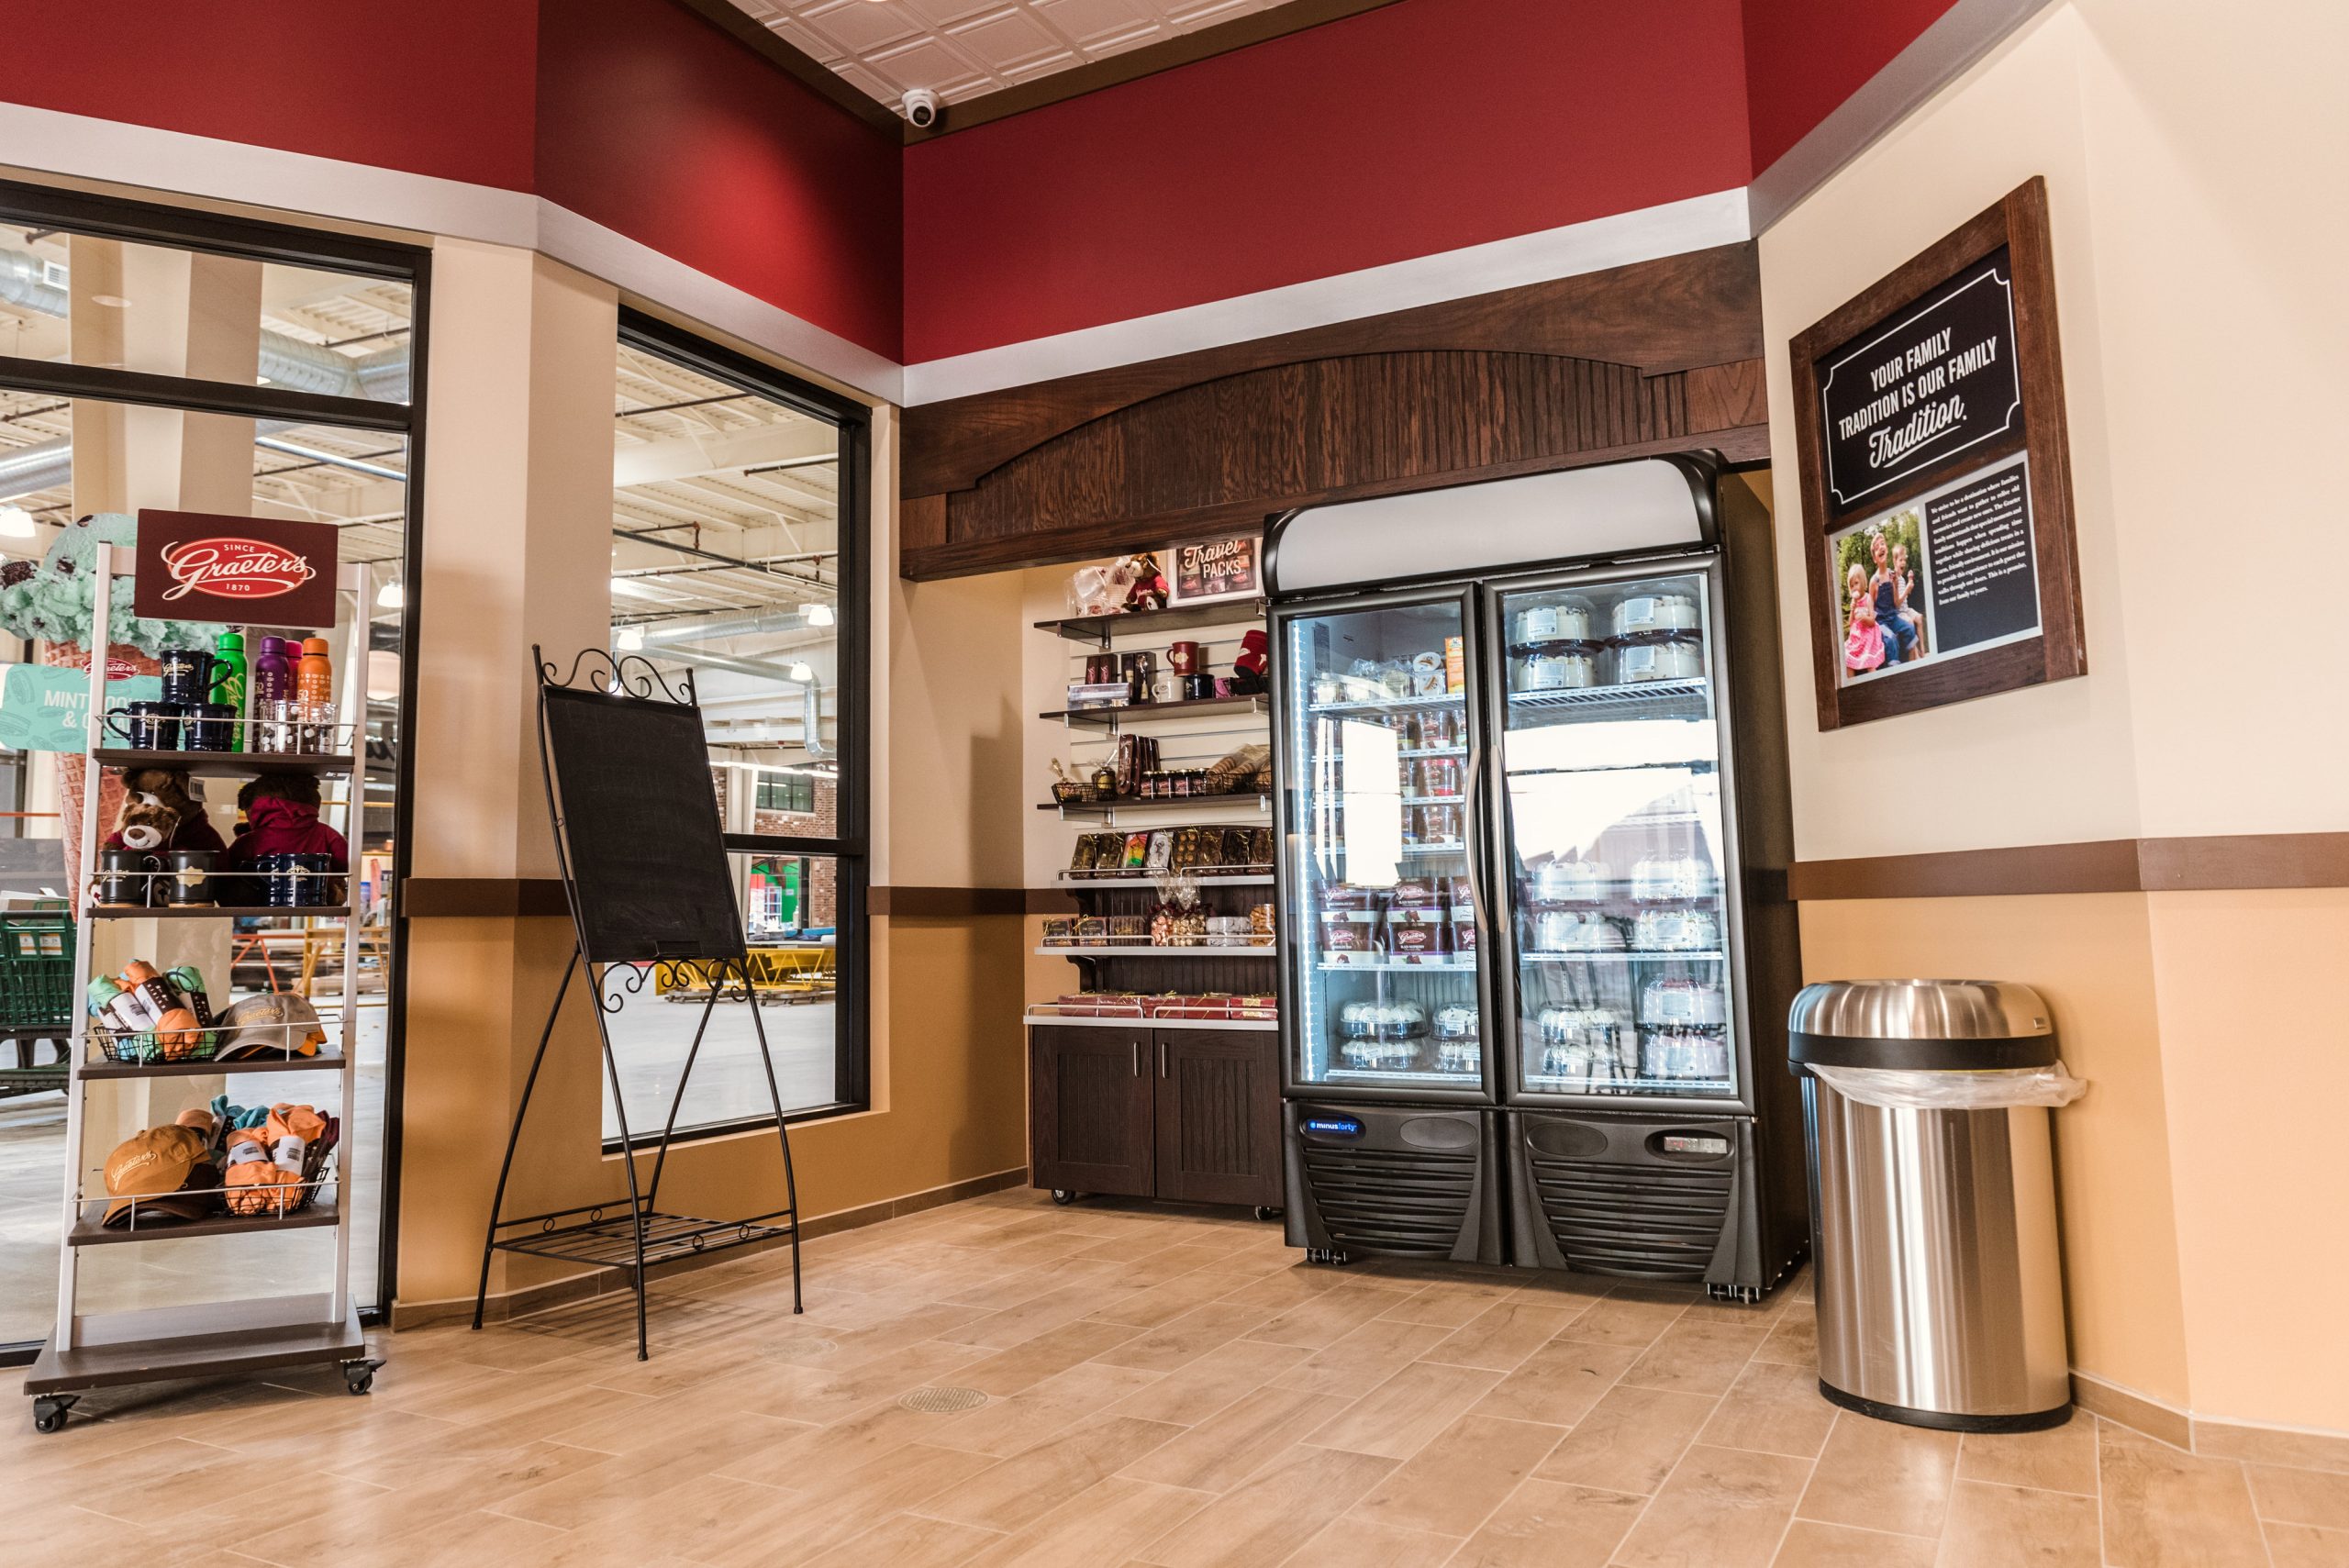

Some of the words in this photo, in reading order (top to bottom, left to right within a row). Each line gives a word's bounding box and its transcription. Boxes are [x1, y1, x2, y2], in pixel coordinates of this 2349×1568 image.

[1871, 356, 1904, 392] YOUR
[1906, 327, 1952, 373] FAMILY
[1839, 390, 1899, 440] TRADITION
[1902, 382, 1916, 408] IS
[1918, 365, 1945, 398] OUR
[1948, 336, 1997, 384] FAMILY
[1868, 395, 1967, 469] Tradition.
[224, 544, 255, 553] SINCE
[1184, 539, 1241, 568] Travel
[161, 540, 317, 600] Graeter's
[1203, 561, 1241, 578] PACKS
[226, 583, 250, 592] 1870
[44, 690, 90, 710] MINT
[62, 711, 77, 728] &
[1316, 1122, 1356, 1132] minusforty
